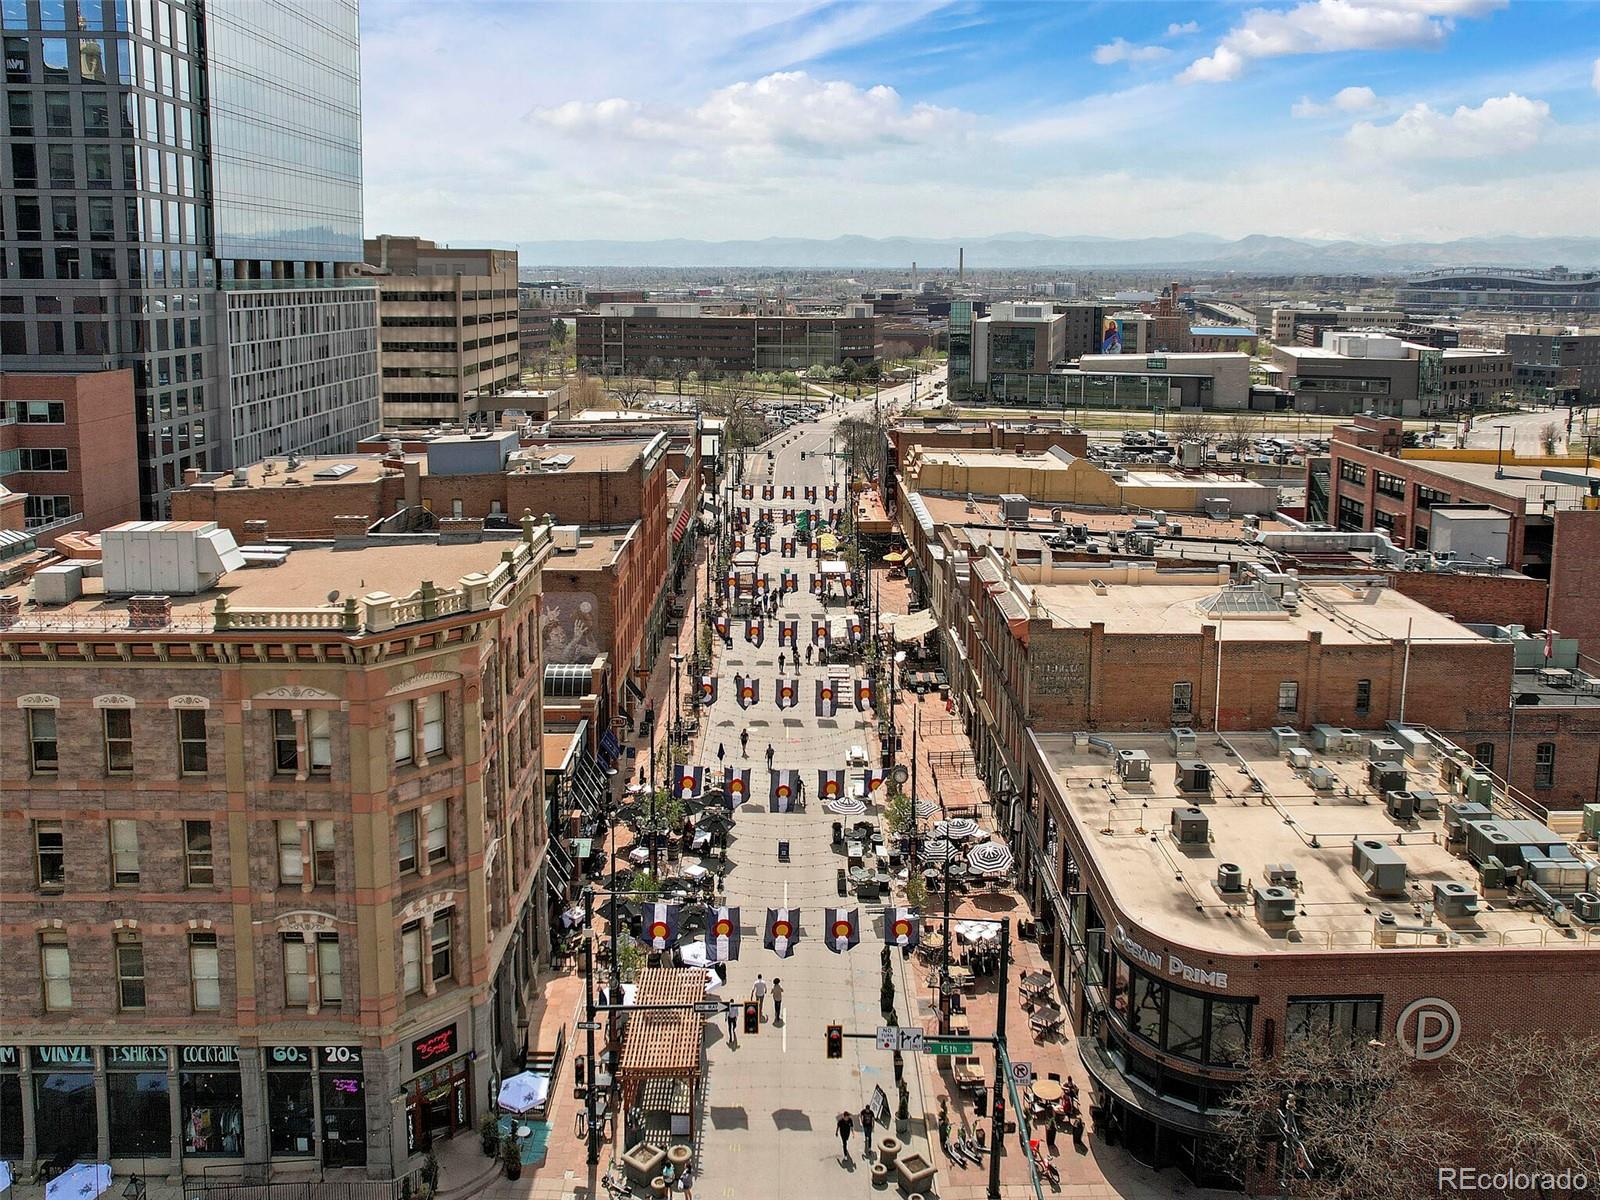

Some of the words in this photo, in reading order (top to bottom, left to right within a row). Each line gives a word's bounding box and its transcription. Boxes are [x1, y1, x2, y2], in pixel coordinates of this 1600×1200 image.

[1169, 955, 1228, 989] PRIME
[40, 1046, 91, 1063] VINYL
[111, 1046, 167, 1063] T-SHIRTS
[273, 1047, 308, 1062] 60s
[940, 1045, 958, 1054] 15th
